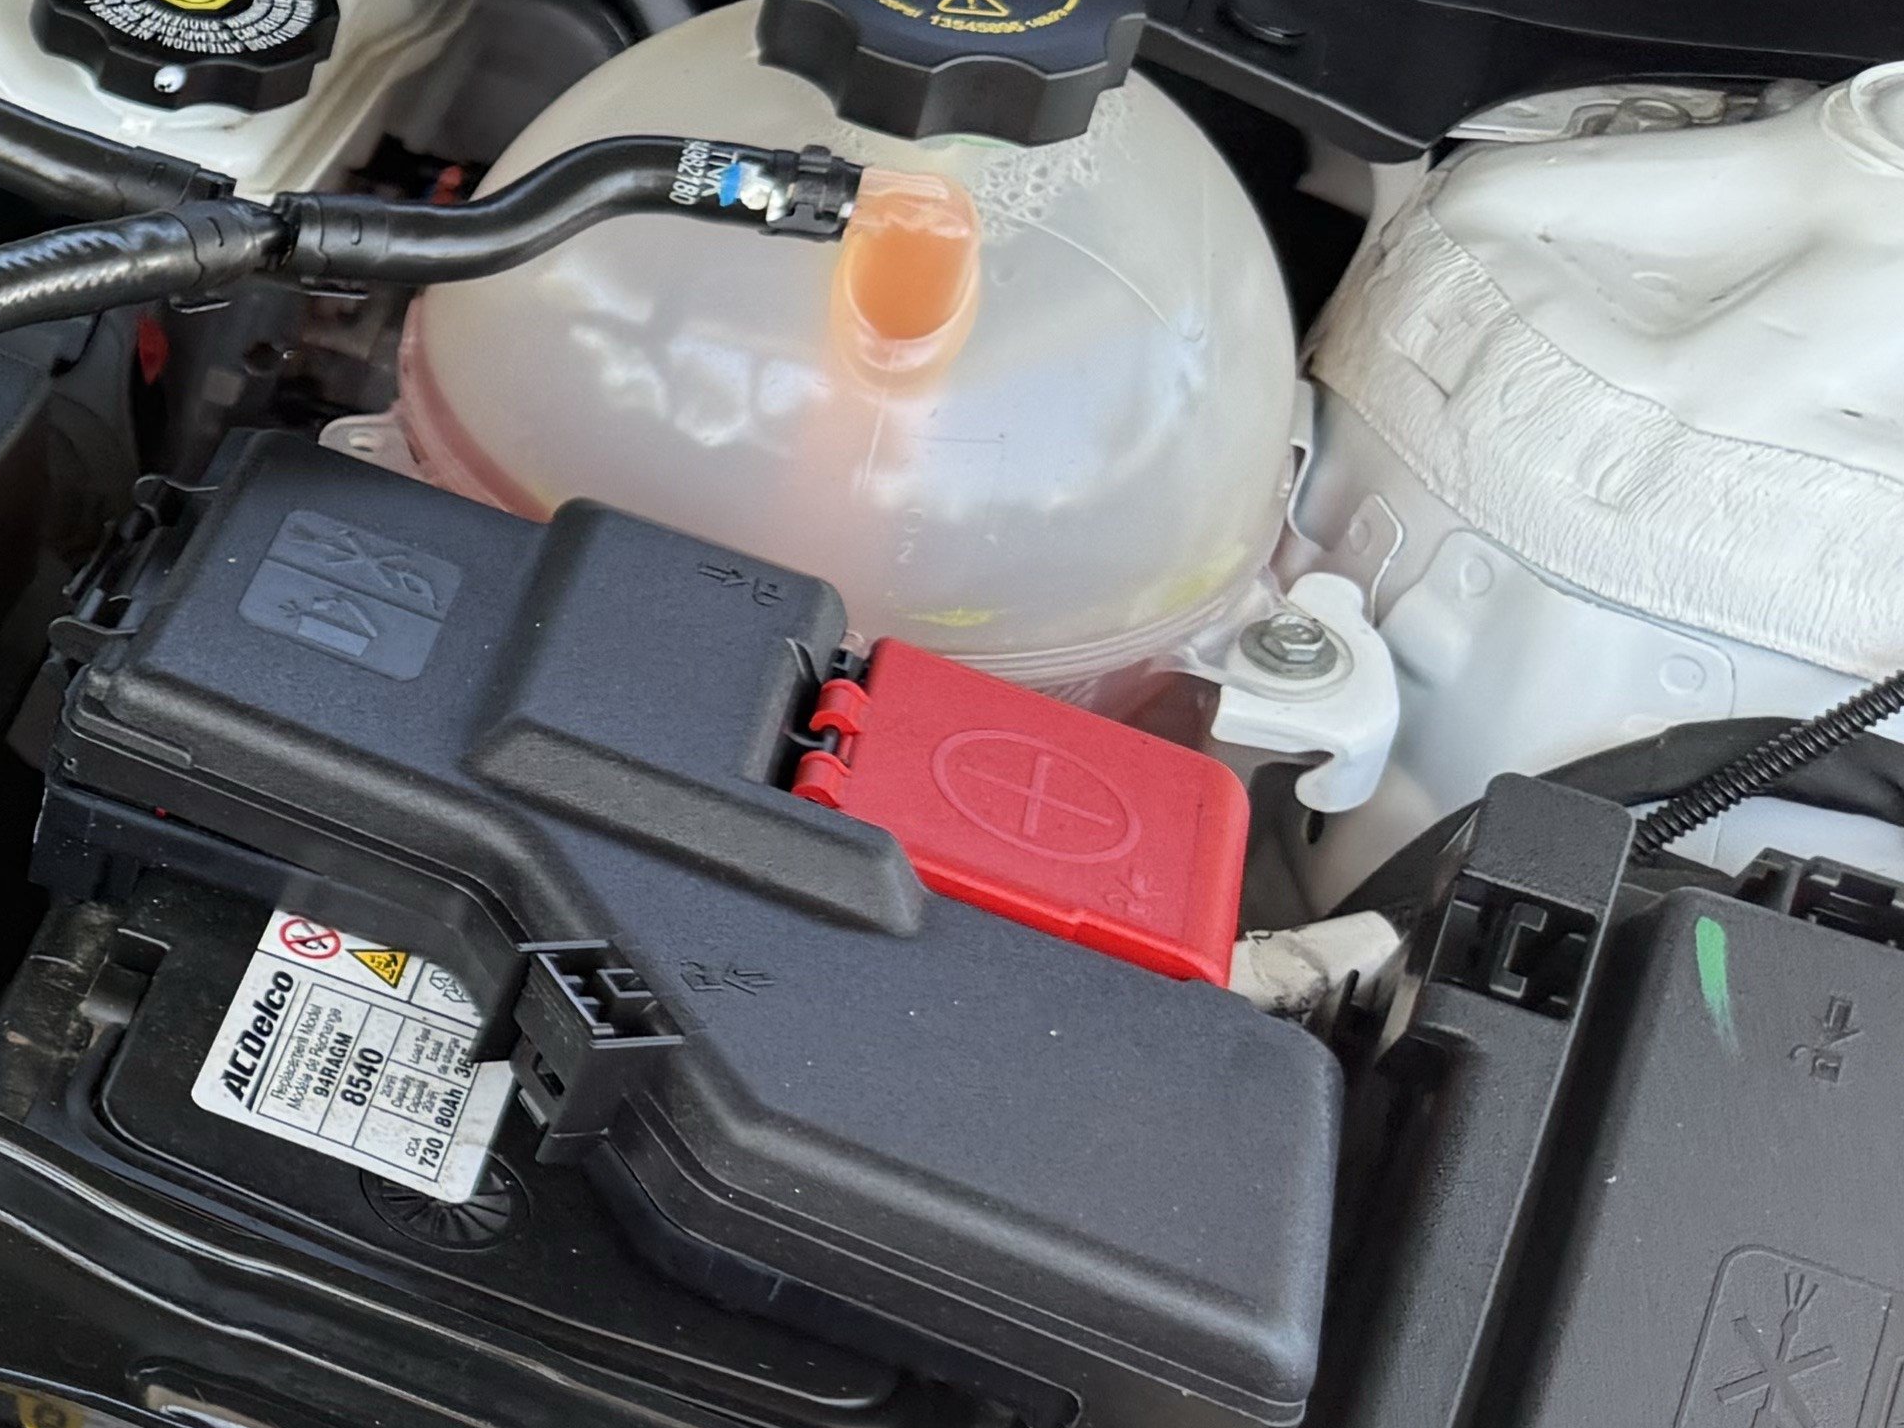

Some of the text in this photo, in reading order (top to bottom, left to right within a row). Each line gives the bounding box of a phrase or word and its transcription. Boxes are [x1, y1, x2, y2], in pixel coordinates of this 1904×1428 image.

[222, 971, 293, 1099] ACDelco
[270, 1003, 322, 1100] Replacement Model
[313, 1031, 352, 1097] 94RAGM
[340, 1047, 383, 1106] 8540
[434, 1088, 463, 1128] 80Ah
[404, 1136, 422, 1157] CCA
[418, 1137, 443, 1167] 730
